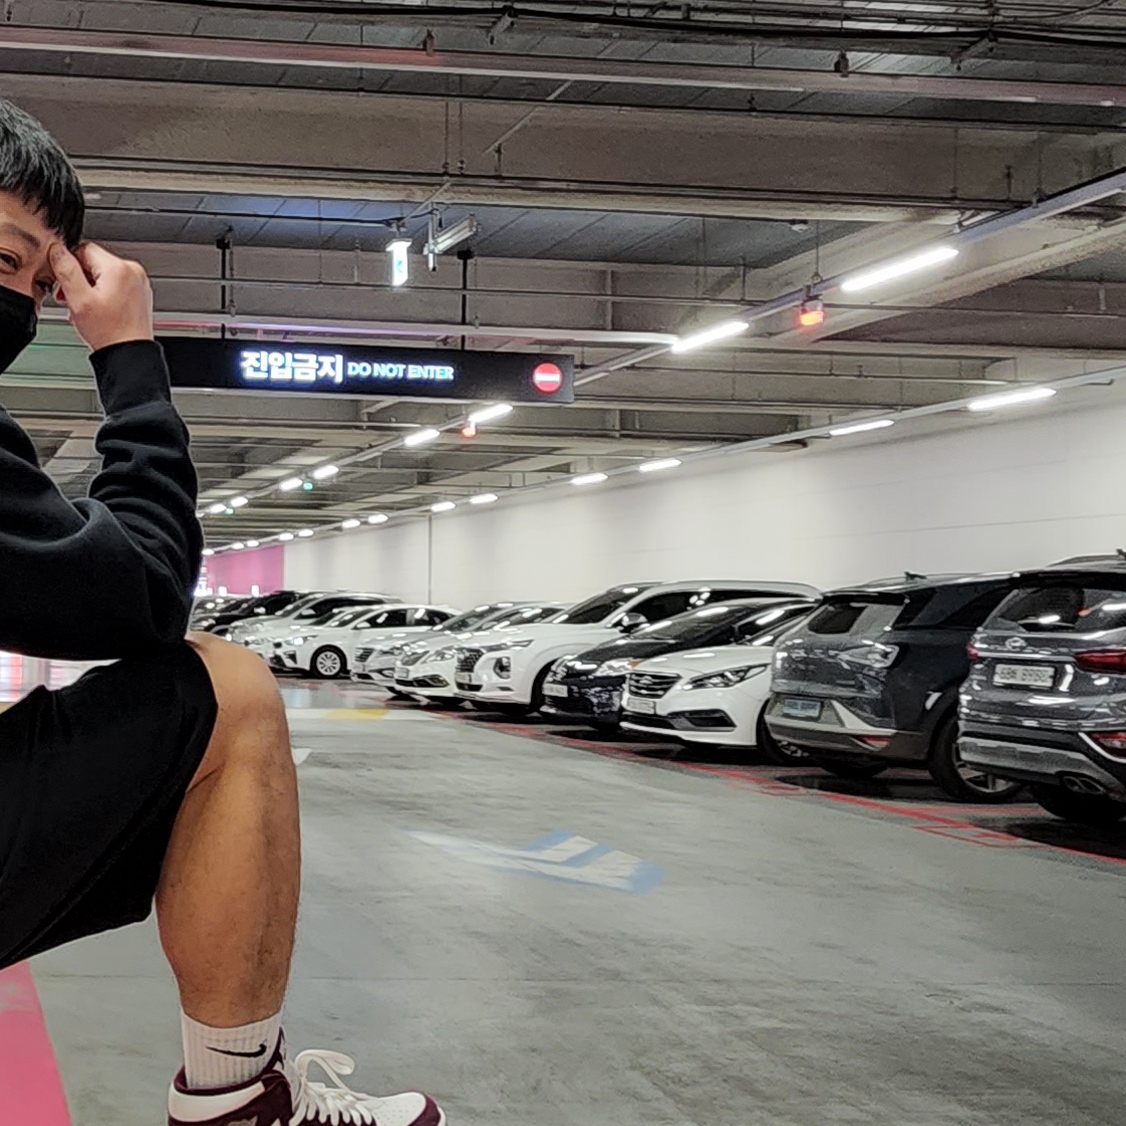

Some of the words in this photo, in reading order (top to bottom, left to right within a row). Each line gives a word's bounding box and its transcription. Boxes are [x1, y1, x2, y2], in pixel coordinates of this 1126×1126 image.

[241, 350, 344, 383] 진입금지
[347, 361, 372, 379] DO
[374, 362, 406, 379] NOT
[406, 364, 455, 380] ENTER
